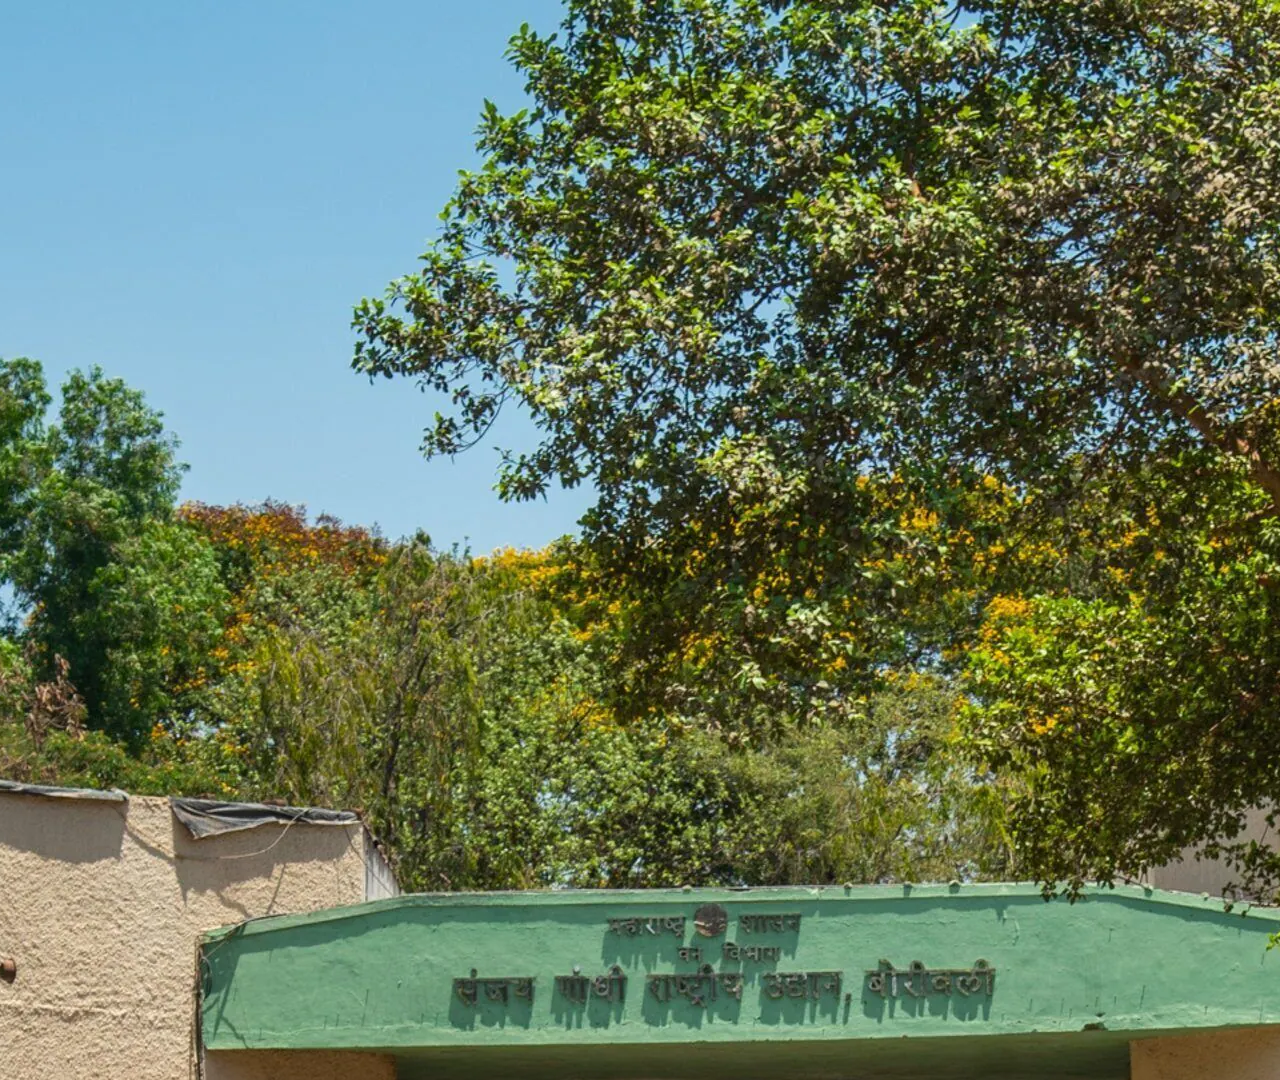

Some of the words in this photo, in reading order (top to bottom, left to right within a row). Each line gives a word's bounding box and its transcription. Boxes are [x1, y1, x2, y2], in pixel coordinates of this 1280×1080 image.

[739, 912, 802, 934] शासन
[677, 946, 702, 962] वन
[722, 941, 781, 962] विभाग
